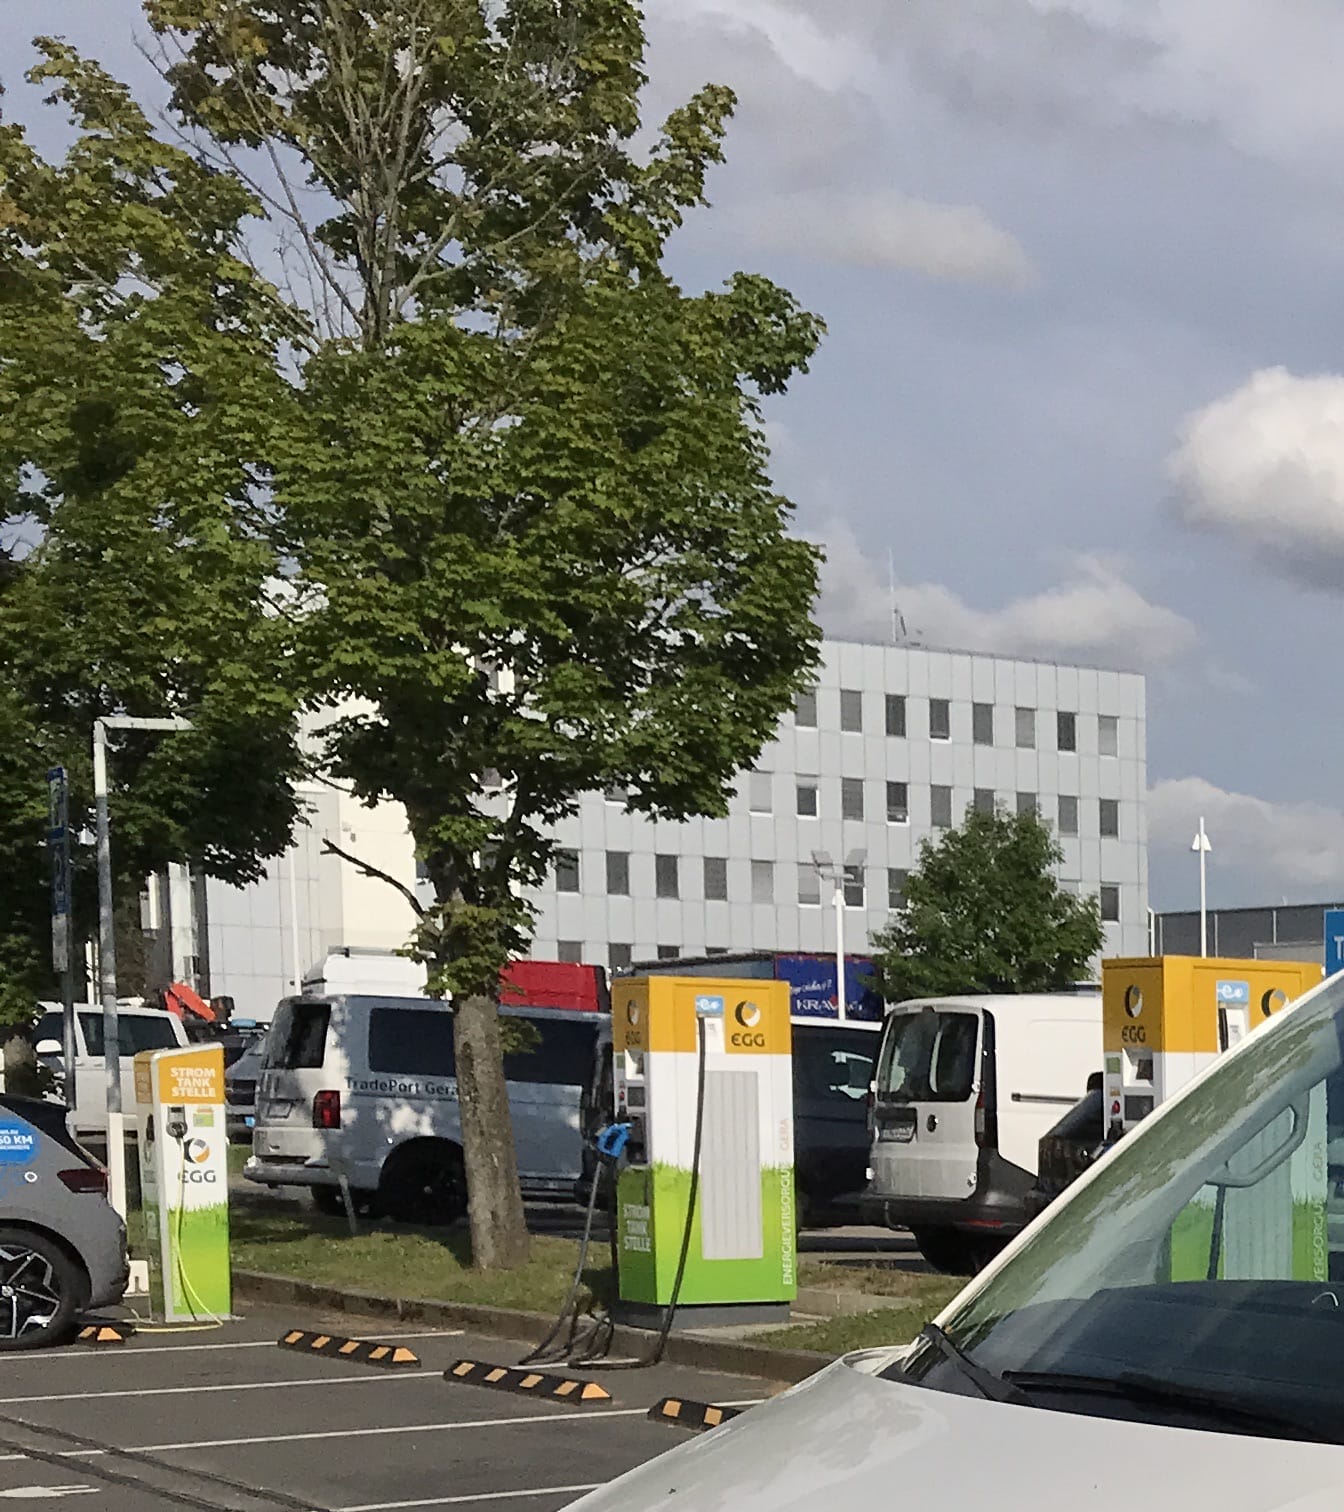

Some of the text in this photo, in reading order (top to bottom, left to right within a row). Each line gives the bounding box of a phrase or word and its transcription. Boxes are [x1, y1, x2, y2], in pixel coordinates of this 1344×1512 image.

[731, 1033, 765, 1047] EGG
[1121, 1025, 1146, 1043] EGG
[170, 1067, 216, 1078] STROM
[176, 1077, 211, 1087] TANK
[344, 1076, 458, 1096] TradePort Gera
[171, 1087, 216, 1097] STELLE
[13, 1135, 34, 1145] KM
[178, 1170, 216, 1183] EGG
